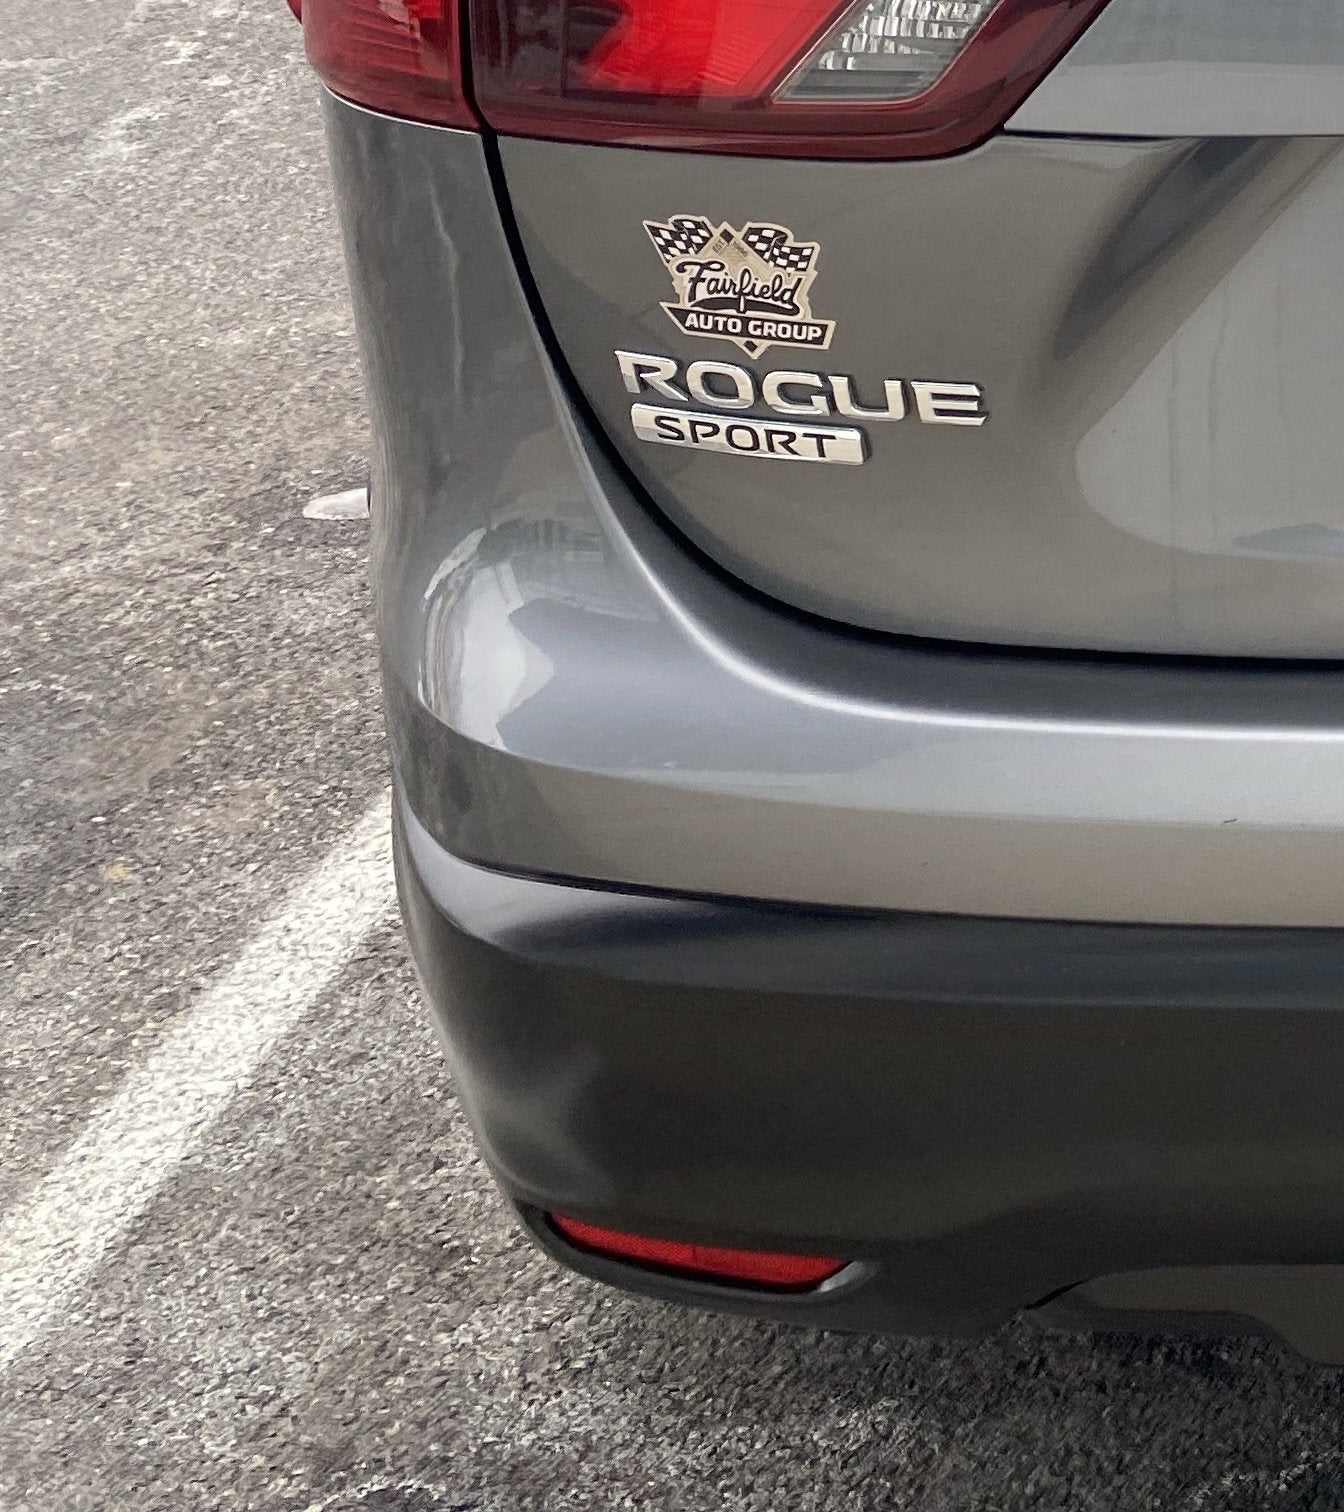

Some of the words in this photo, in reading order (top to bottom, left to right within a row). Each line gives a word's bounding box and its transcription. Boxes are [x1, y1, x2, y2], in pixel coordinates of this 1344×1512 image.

[676, 260, 802, 310] Fairfield
[684, 313, 742, 333] AUTO
[748, 320, 822, 341] GROUP
[614, 350, 989, 427] ROGUE
[654, 416, 836, 459] SPORT
